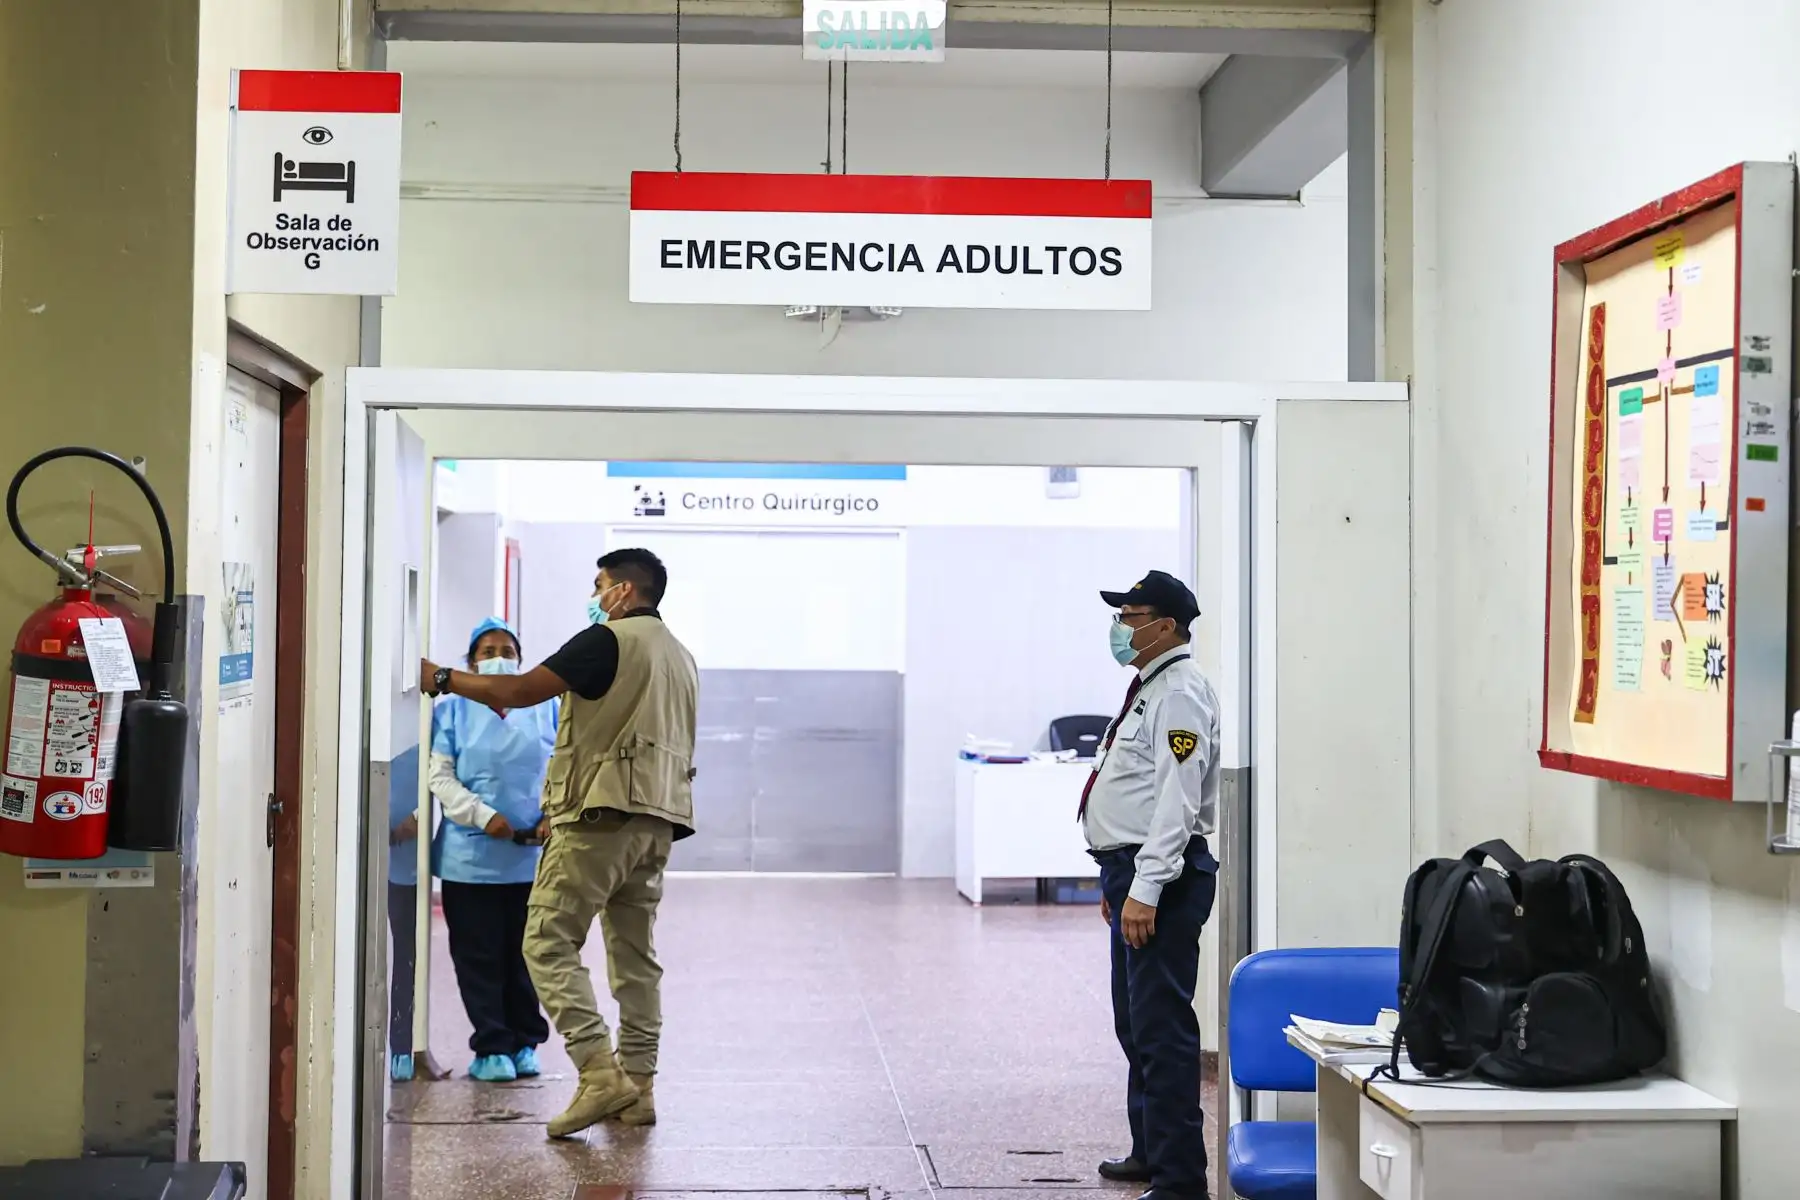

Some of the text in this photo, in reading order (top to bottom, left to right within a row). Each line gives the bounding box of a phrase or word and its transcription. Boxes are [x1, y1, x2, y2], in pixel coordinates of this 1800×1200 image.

[816, 9, 933, 51] SALIDA
[275, 213, 352, 231] Sala de
[246, 232, 379, 252] Observación
[304, 252, 321, 270] G
[660, 239, 1123, 276] EMERGENCIA ADULTOS
[682, 492, 879, 516] Centro Quirúrgico
[1172, 737, 1194, 755] SP
[89, 787, 104, 804] 192
